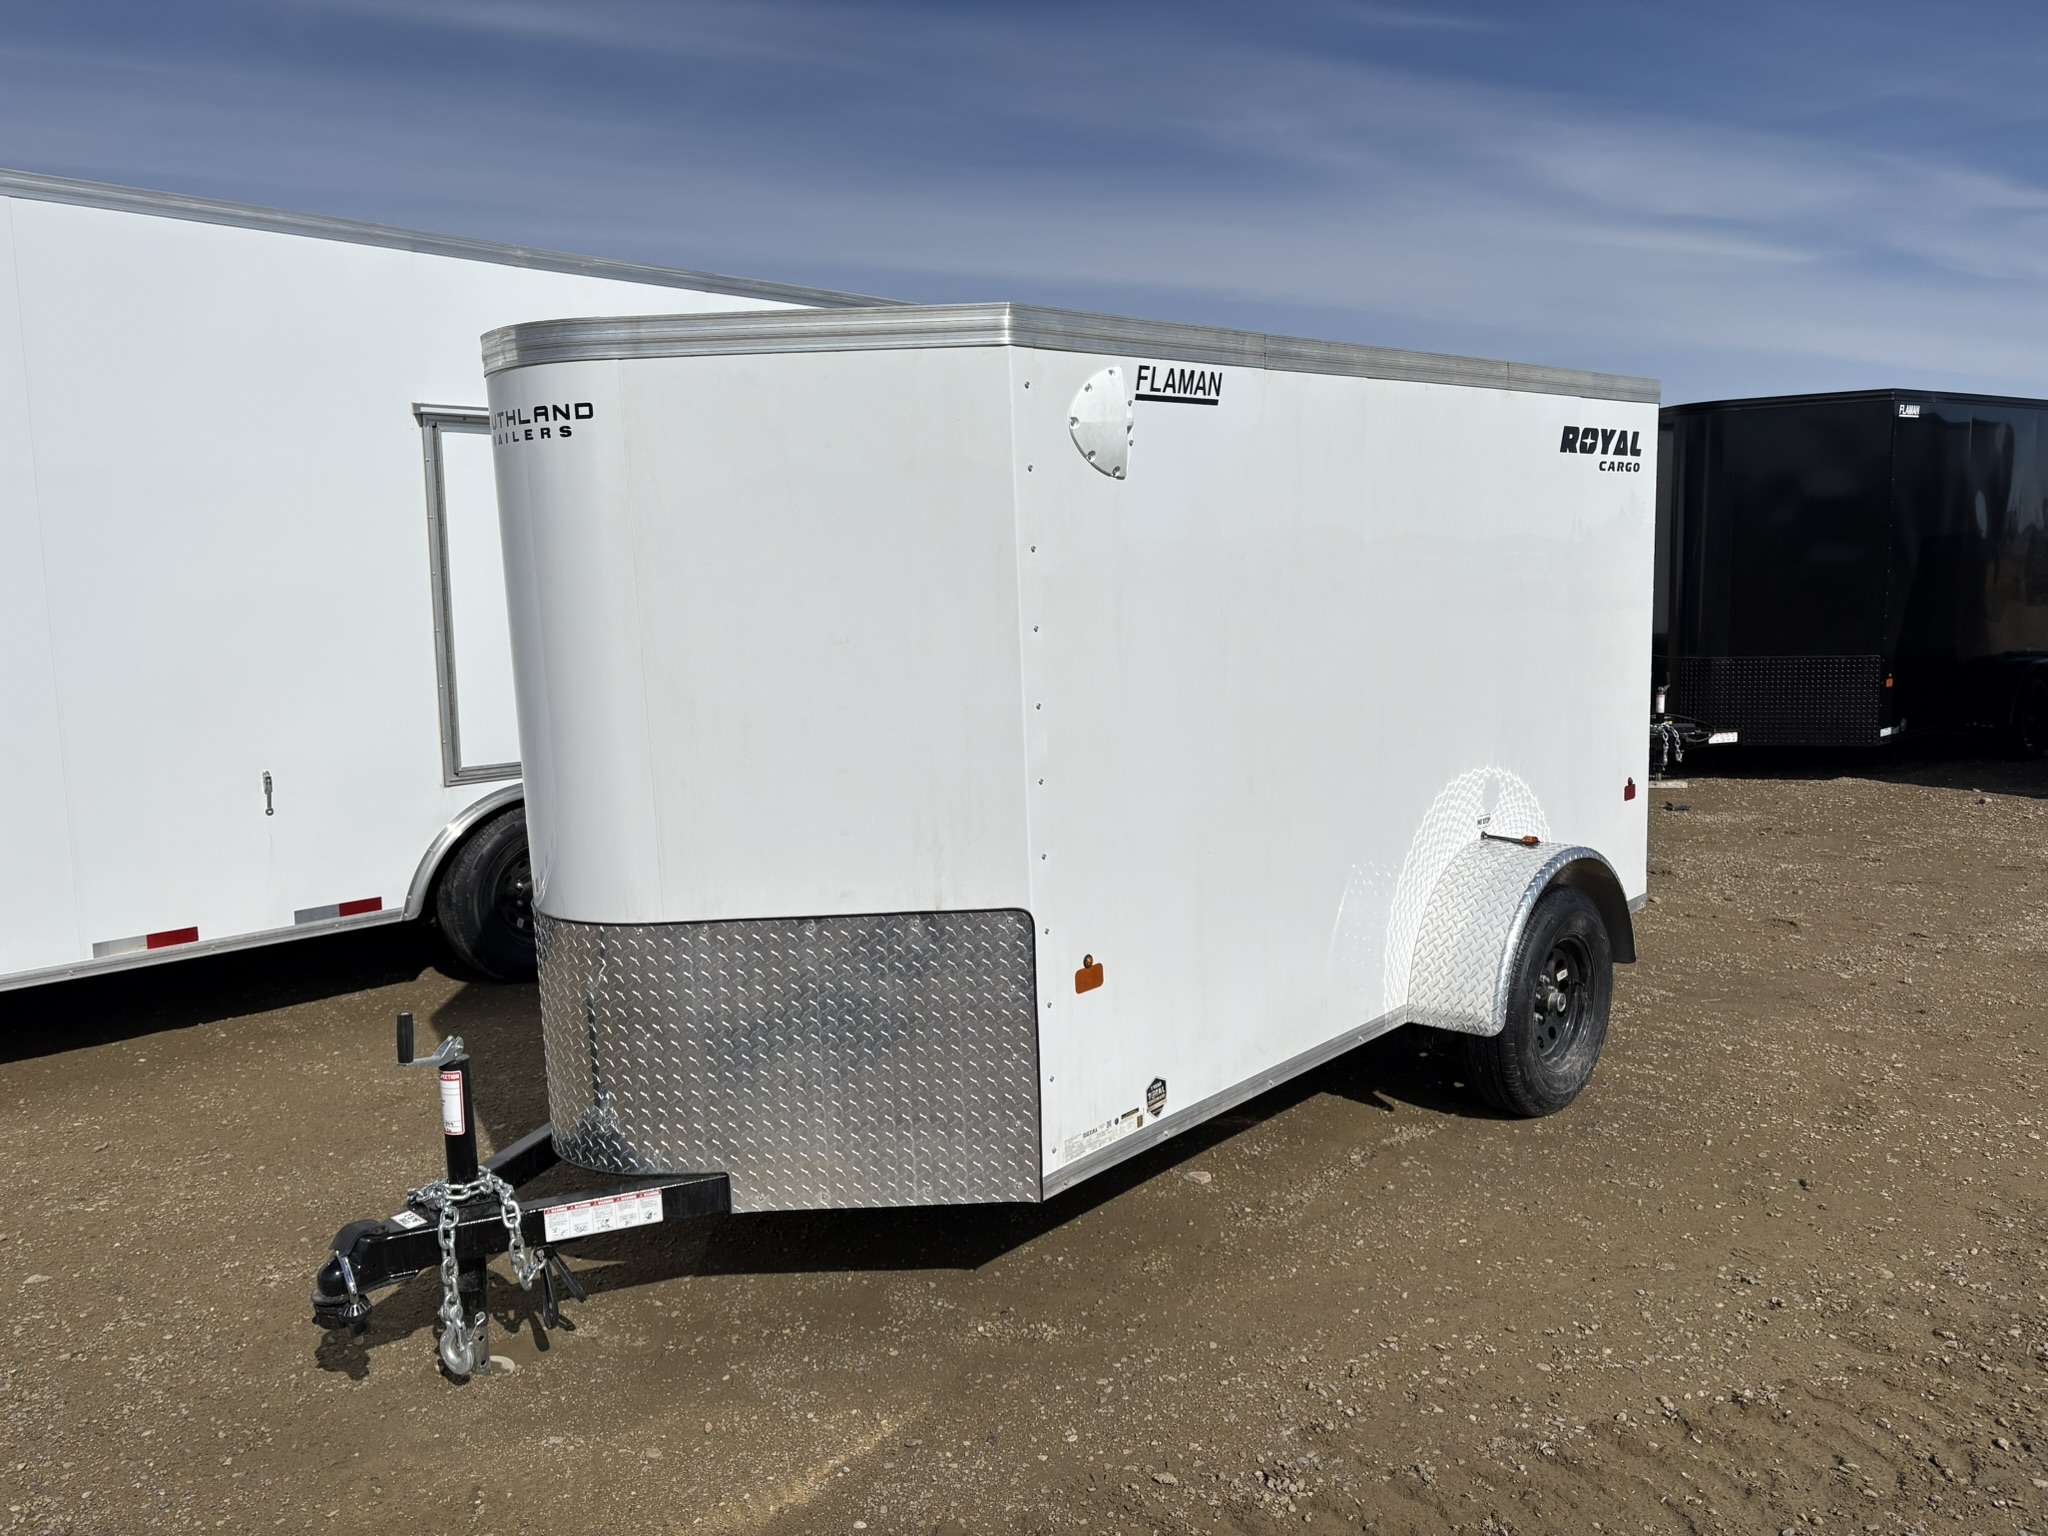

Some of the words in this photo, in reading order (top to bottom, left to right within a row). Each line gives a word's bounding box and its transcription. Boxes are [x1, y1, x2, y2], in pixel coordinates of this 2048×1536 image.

[1135, 364, 1223, 397] FLAMAN
[490, 402, 593, 430] UTHLAND
[497, 425, 572, 445] AILERS
[1560, 425, 1642, 457] ROYAL
[1599, 461, 1640, 472] CARGO
